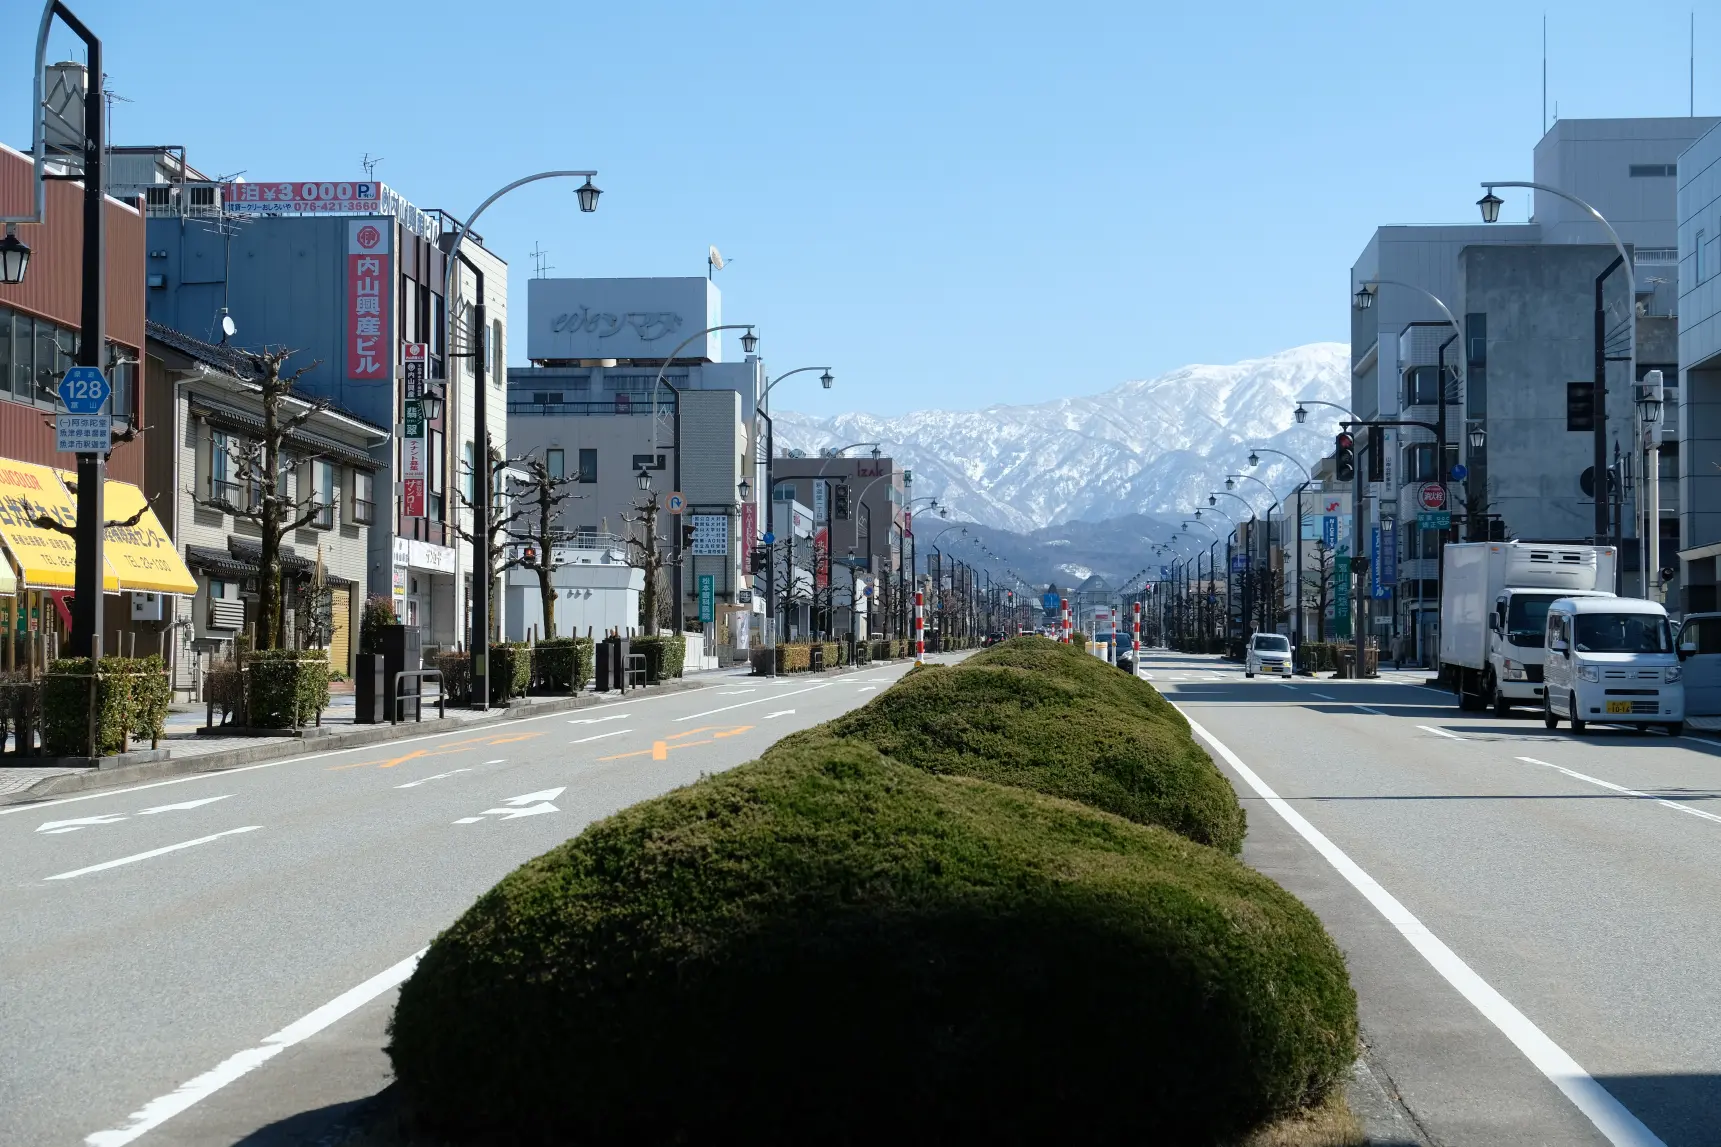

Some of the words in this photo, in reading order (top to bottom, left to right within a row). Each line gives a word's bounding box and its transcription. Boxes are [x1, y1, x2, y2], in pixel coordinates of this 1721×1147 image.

[293, 202, 378, 212] 076-421-3660
[355, 256, 381, 374] 内山興産ビル
[66, 380, 102, 399] 128
[1424, 491, 1444, 501] 消火栓
[701, 577, 711, 620] 松本眼科医院
[1337, 563, 1348, 617] 富山第一銀行
